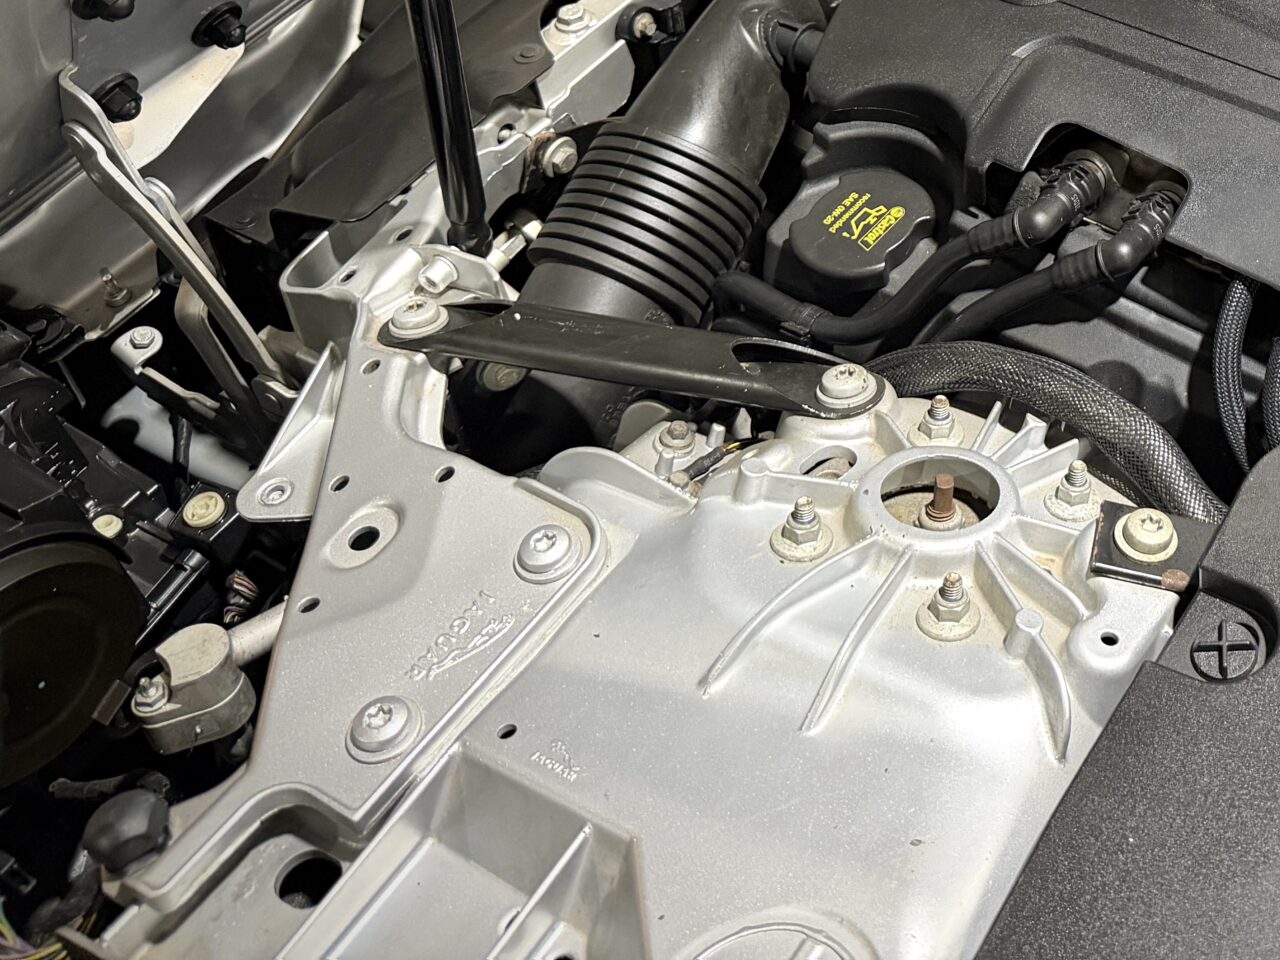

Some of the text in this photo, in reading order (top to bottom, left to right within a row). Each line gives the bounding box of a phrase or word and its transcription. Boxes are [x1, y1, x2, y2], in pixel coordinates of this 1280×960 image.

[829, 193, 871, 233] recommended
[842, 192, 859, 206] SAE
[864, 215, 896, 244] Castrol
[405, 589, 496, 680] JAGUAR
